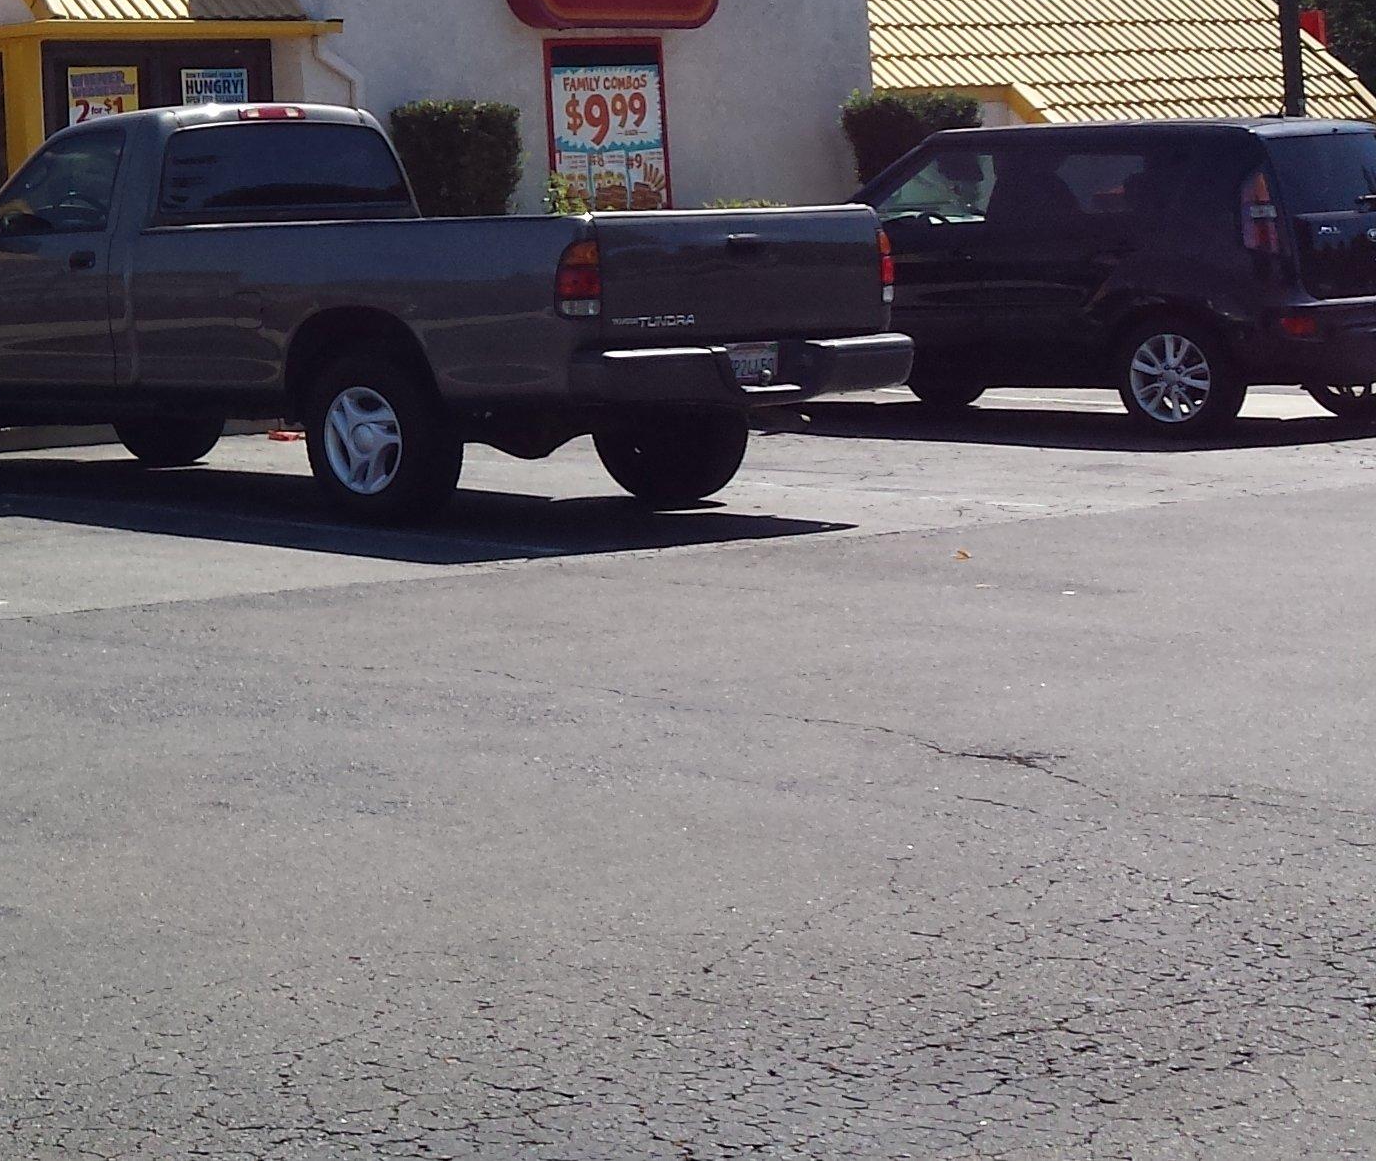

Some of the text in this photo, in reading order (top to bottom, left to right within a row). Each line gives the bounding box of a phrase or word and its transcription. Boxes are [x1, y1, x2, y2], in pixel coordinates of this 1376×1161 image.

[185, 78, 245, 95] HUNGRY!
[563, 74, 648, 92] FAMILY COMBOS
[75, 98, 91, 123] 2
[91, 105, 103, 115] for
[638, 314, 695, 328] TUNDRA
